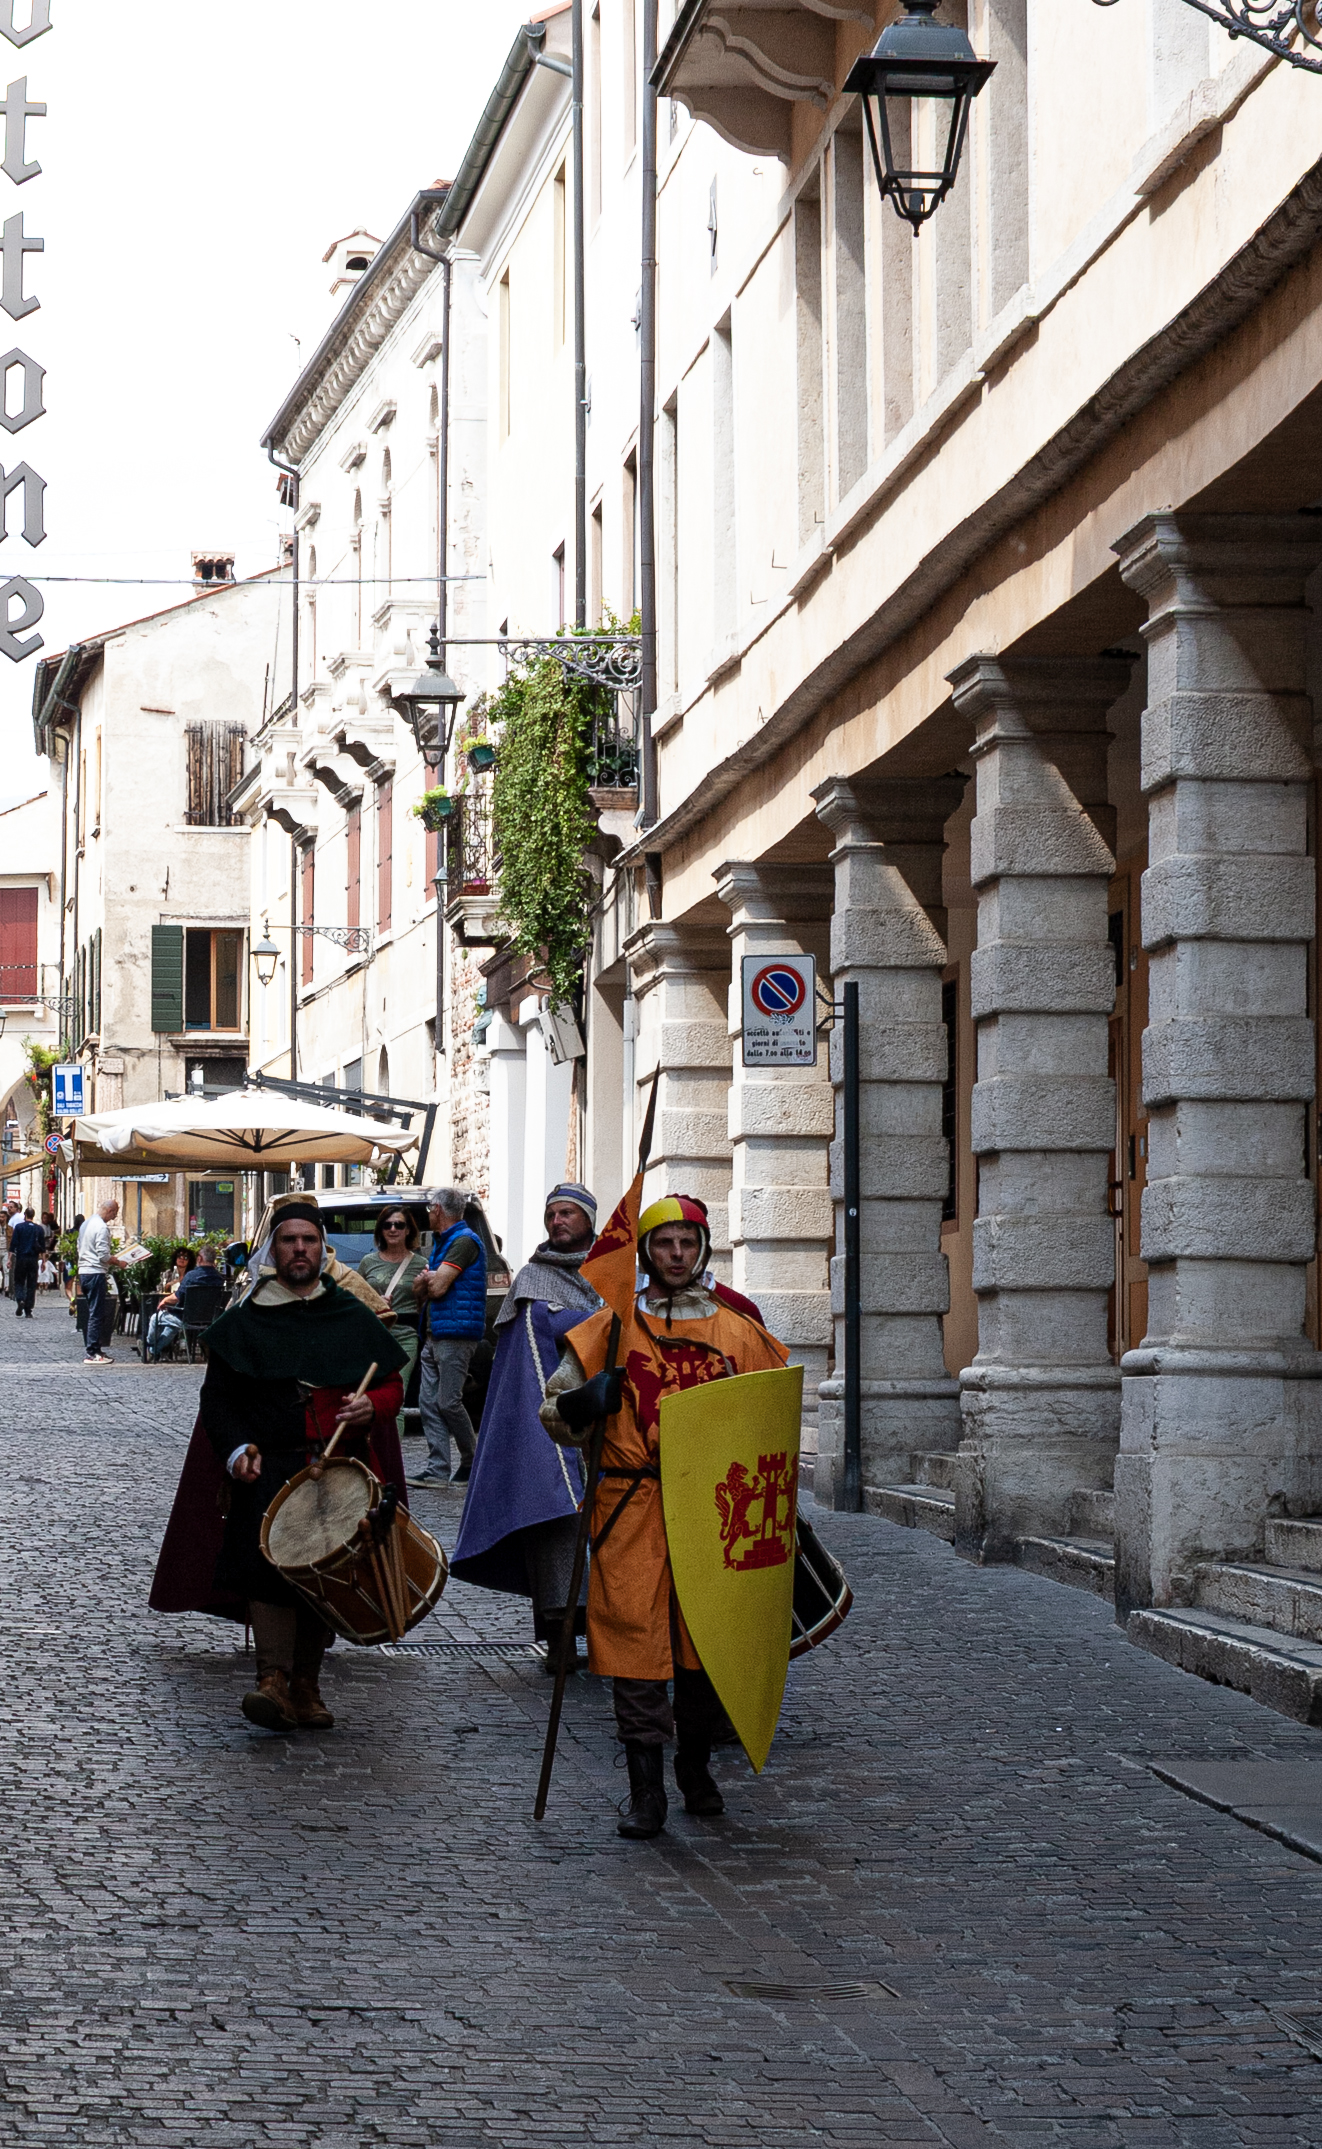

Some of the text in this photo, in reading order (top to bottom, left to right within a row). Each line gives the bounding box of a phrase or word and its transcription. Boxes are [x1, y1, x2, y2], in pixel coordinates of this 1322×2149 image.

[751, 1039, 769, 1048] giorni
[772, 1039, 779, 1047] di
[746, 1049, 763, 1057] dalle
[780, 1049, 793, 1057] alle
[56, 1066, 81, 1101] T
